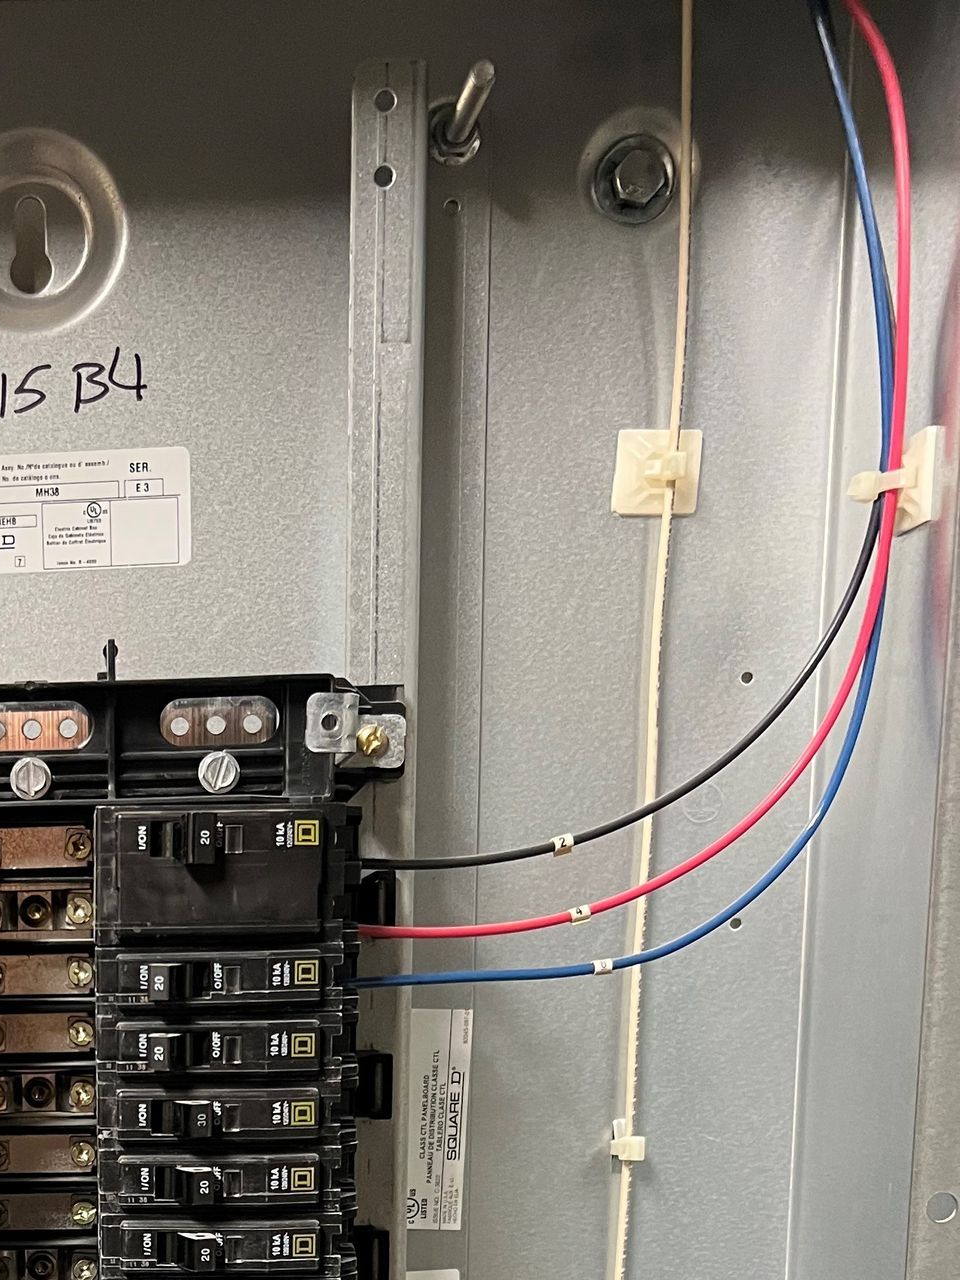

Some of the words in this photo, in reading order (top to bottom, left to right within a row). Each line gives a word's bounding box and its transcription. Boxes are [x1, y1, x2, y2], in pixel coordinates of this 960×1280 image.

[0, 364, 51, 418] 15
[72, 347, 147, 413] B4
[129, 462, 152, 473] SER.
[36, 487, 59, 496] MH38
[136, 483, 140, 492] E
[144, 483, 149, 492] 3
[2, 535, 15, 545] D
[138, 826, 146, 849] I/ON
[200, 831, 209, 844] 20
[559, 837, 567, 848] 2
[576, 906, 583, 916] 4
[140, 966, 148, 989] I/ON
[155, 976, 164, 990] 20
[139, 1034, 147, 1057] I/ON
[154, 1047, 163, 1060] 20
[451, 1071, 461, 1084] D
[421, 1075, 429, 1121] PANELBOARD
[197, 1114, 206, 1126] 30
[447, 1092, 460, 1160] SQUARE
[428, 1141, 434, 1150] DE
[141, 1168, 149, 1190] I/ON
[200, 1181, 208, 1194] 20
[143, 1234, 151, 1255] I/ON
[201, 1249, 210, 1261] 20
